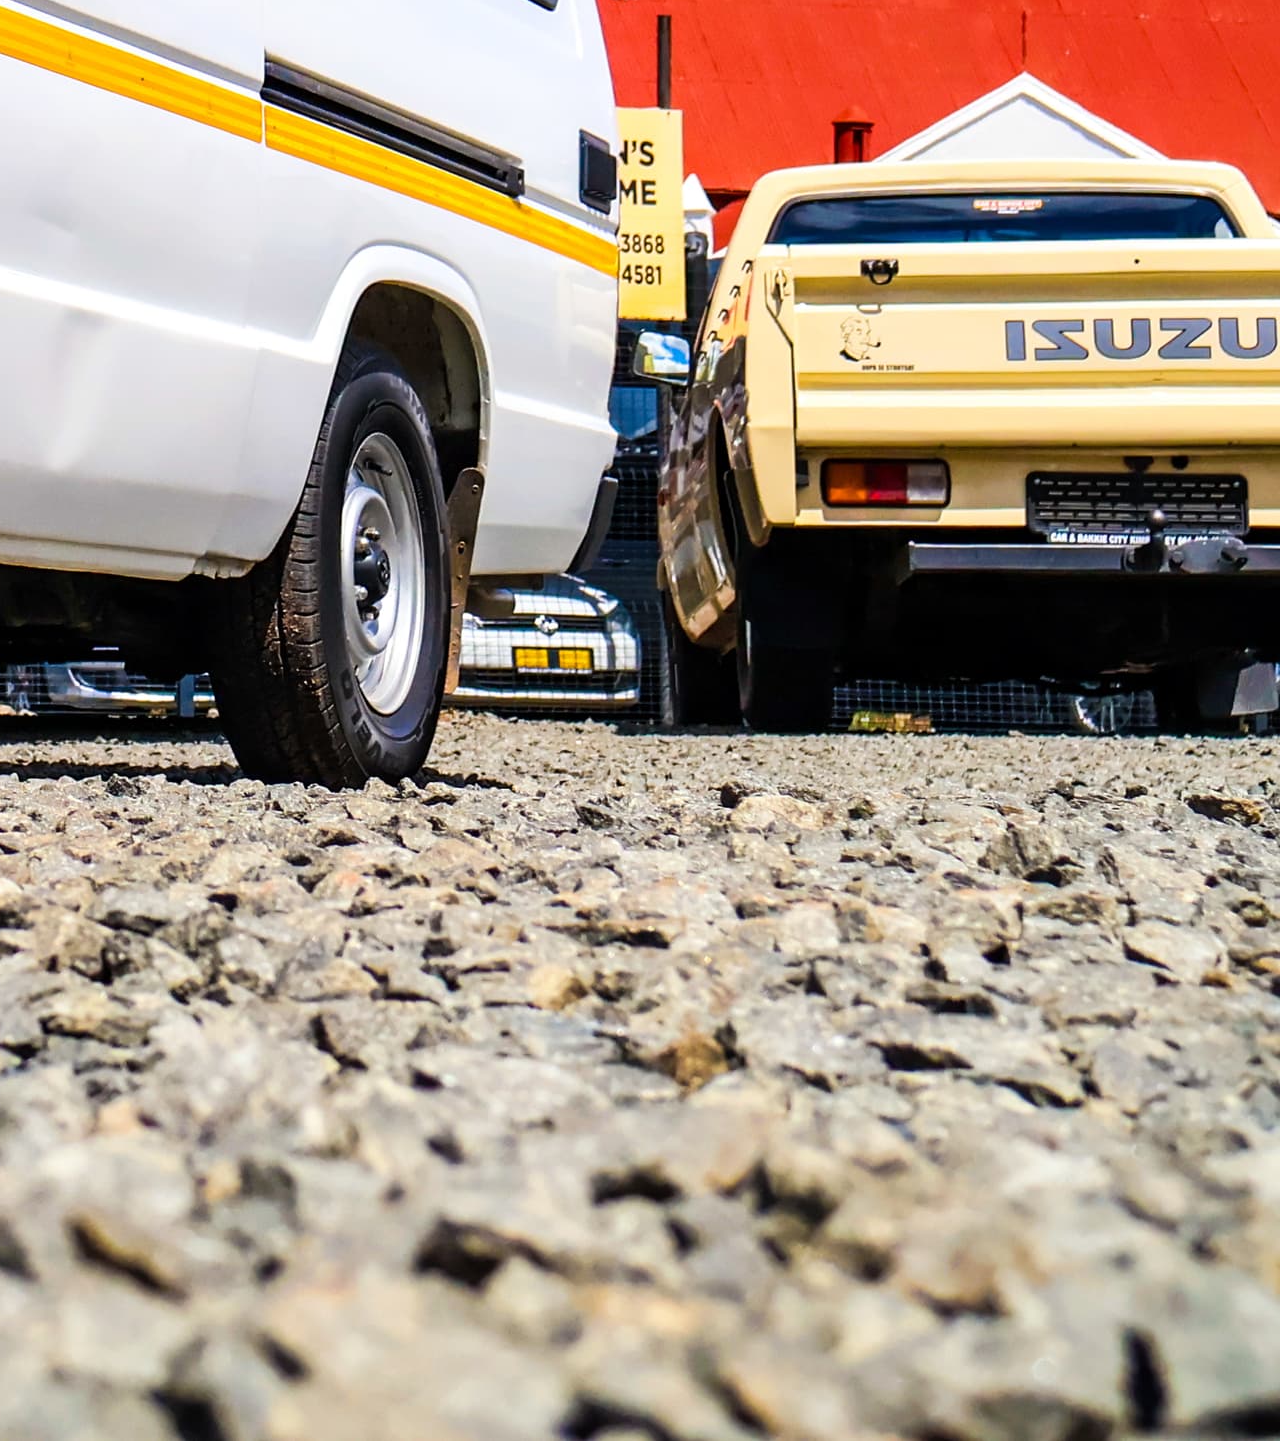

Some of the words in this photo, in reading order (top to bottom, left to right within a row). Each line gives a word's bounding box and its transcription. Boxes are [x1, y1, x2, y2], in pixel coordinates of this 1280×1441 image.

[621, 234, 665, 255] 3868
[622, 265, 663, 286] 4581
[1004, 317, 1278, 361] ISUZU
[1051, 532, 1067, 543] CAR
[1109, 534, 1128, 545] CITY
